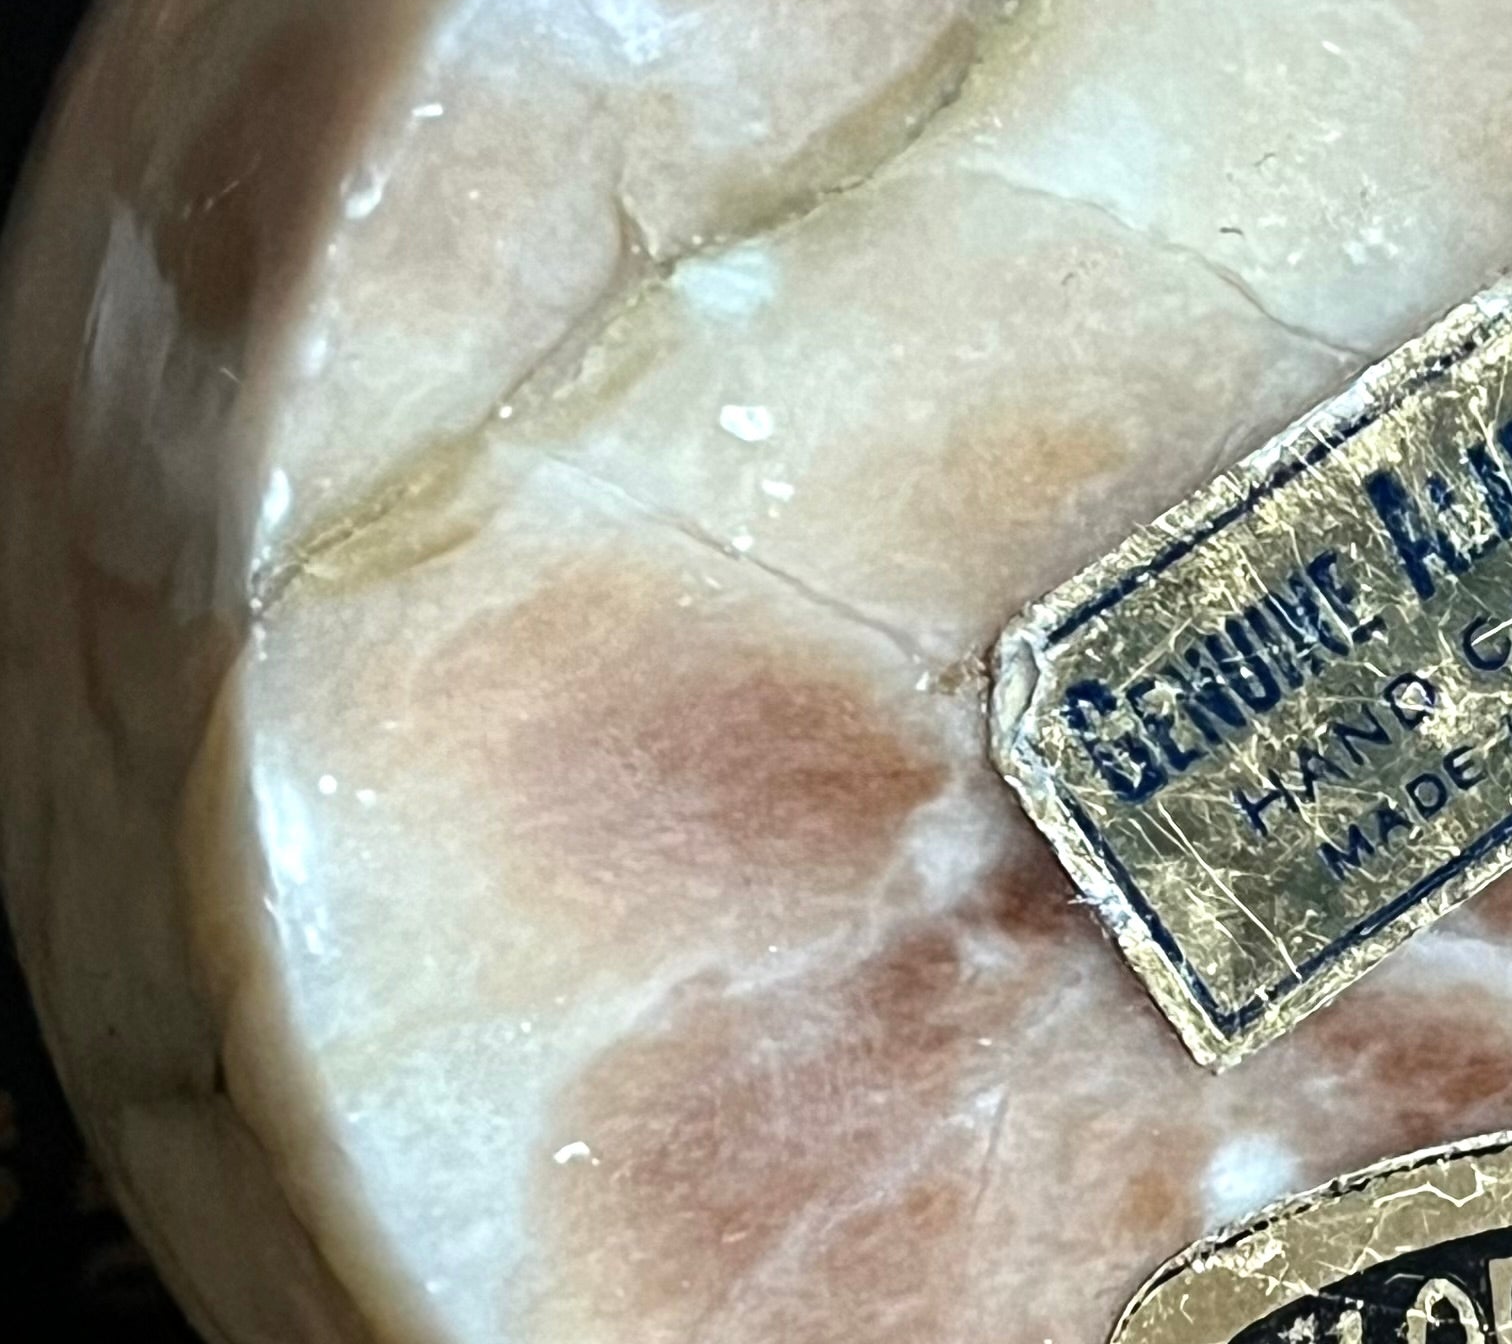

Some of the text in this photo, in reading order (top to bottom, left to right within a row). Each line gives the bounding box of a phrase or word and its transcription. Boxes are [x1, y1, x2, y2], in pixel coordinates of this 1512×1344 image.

[1058, 549, 1384, 804] GENUINE
[1231, 670, 1437, 838] HAND
[1318, 744, 1486, 882] MADE
